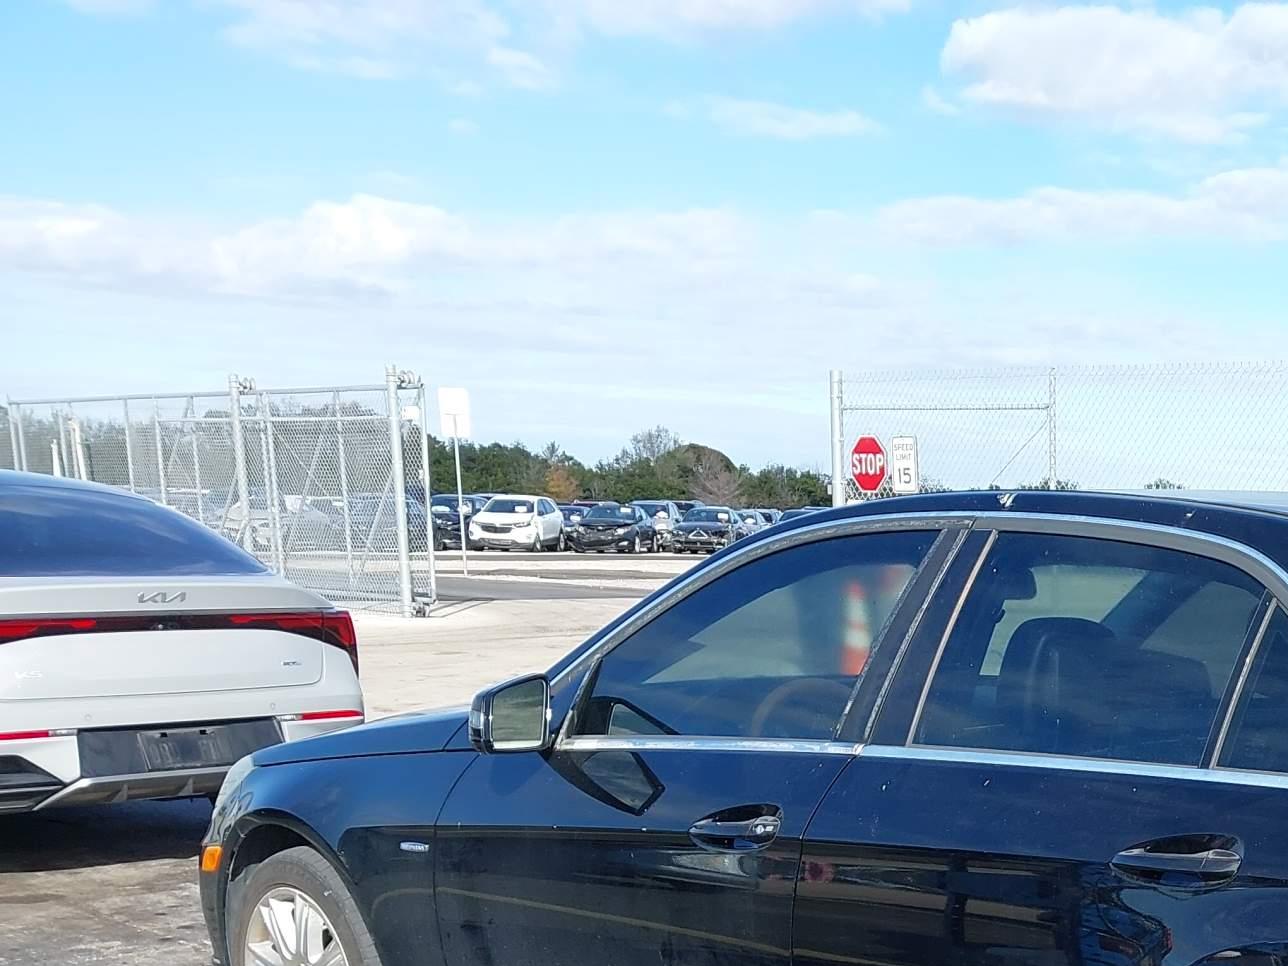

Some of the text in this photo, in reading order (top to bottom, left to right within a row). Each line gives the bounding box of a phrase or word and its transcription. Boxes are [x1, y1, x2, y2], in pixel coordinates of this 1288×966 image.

[893, 443, 914, 452] SPEED
[895, 453, 912, 461] LIMIT
[852, 453, 885, 476] STOP
[897, 467, 912, 484] 15
